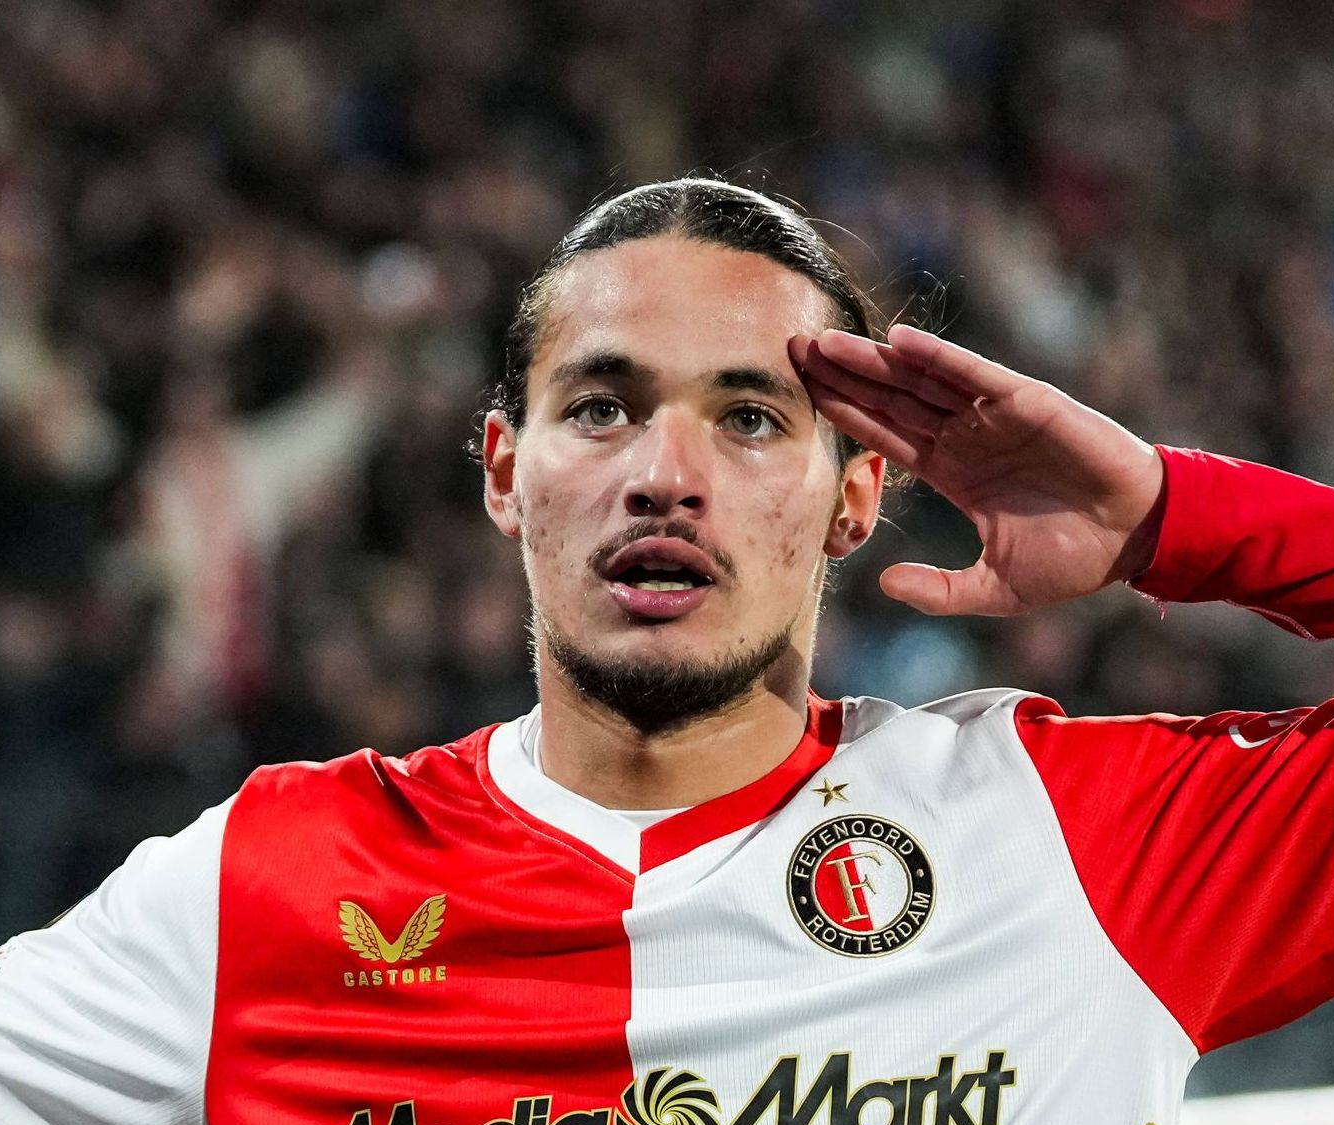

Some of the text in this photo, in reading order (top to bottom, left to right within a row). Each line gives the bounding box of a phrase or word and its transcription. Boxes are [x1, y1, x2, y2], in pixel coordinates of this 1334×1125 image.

[794, 820, 914, 879] FEYENOORD
[825, 850, 884, 924] F
[807, 891, 931, 953] ROTTERDAM
[343, 965, 447, 987] CASTORE
